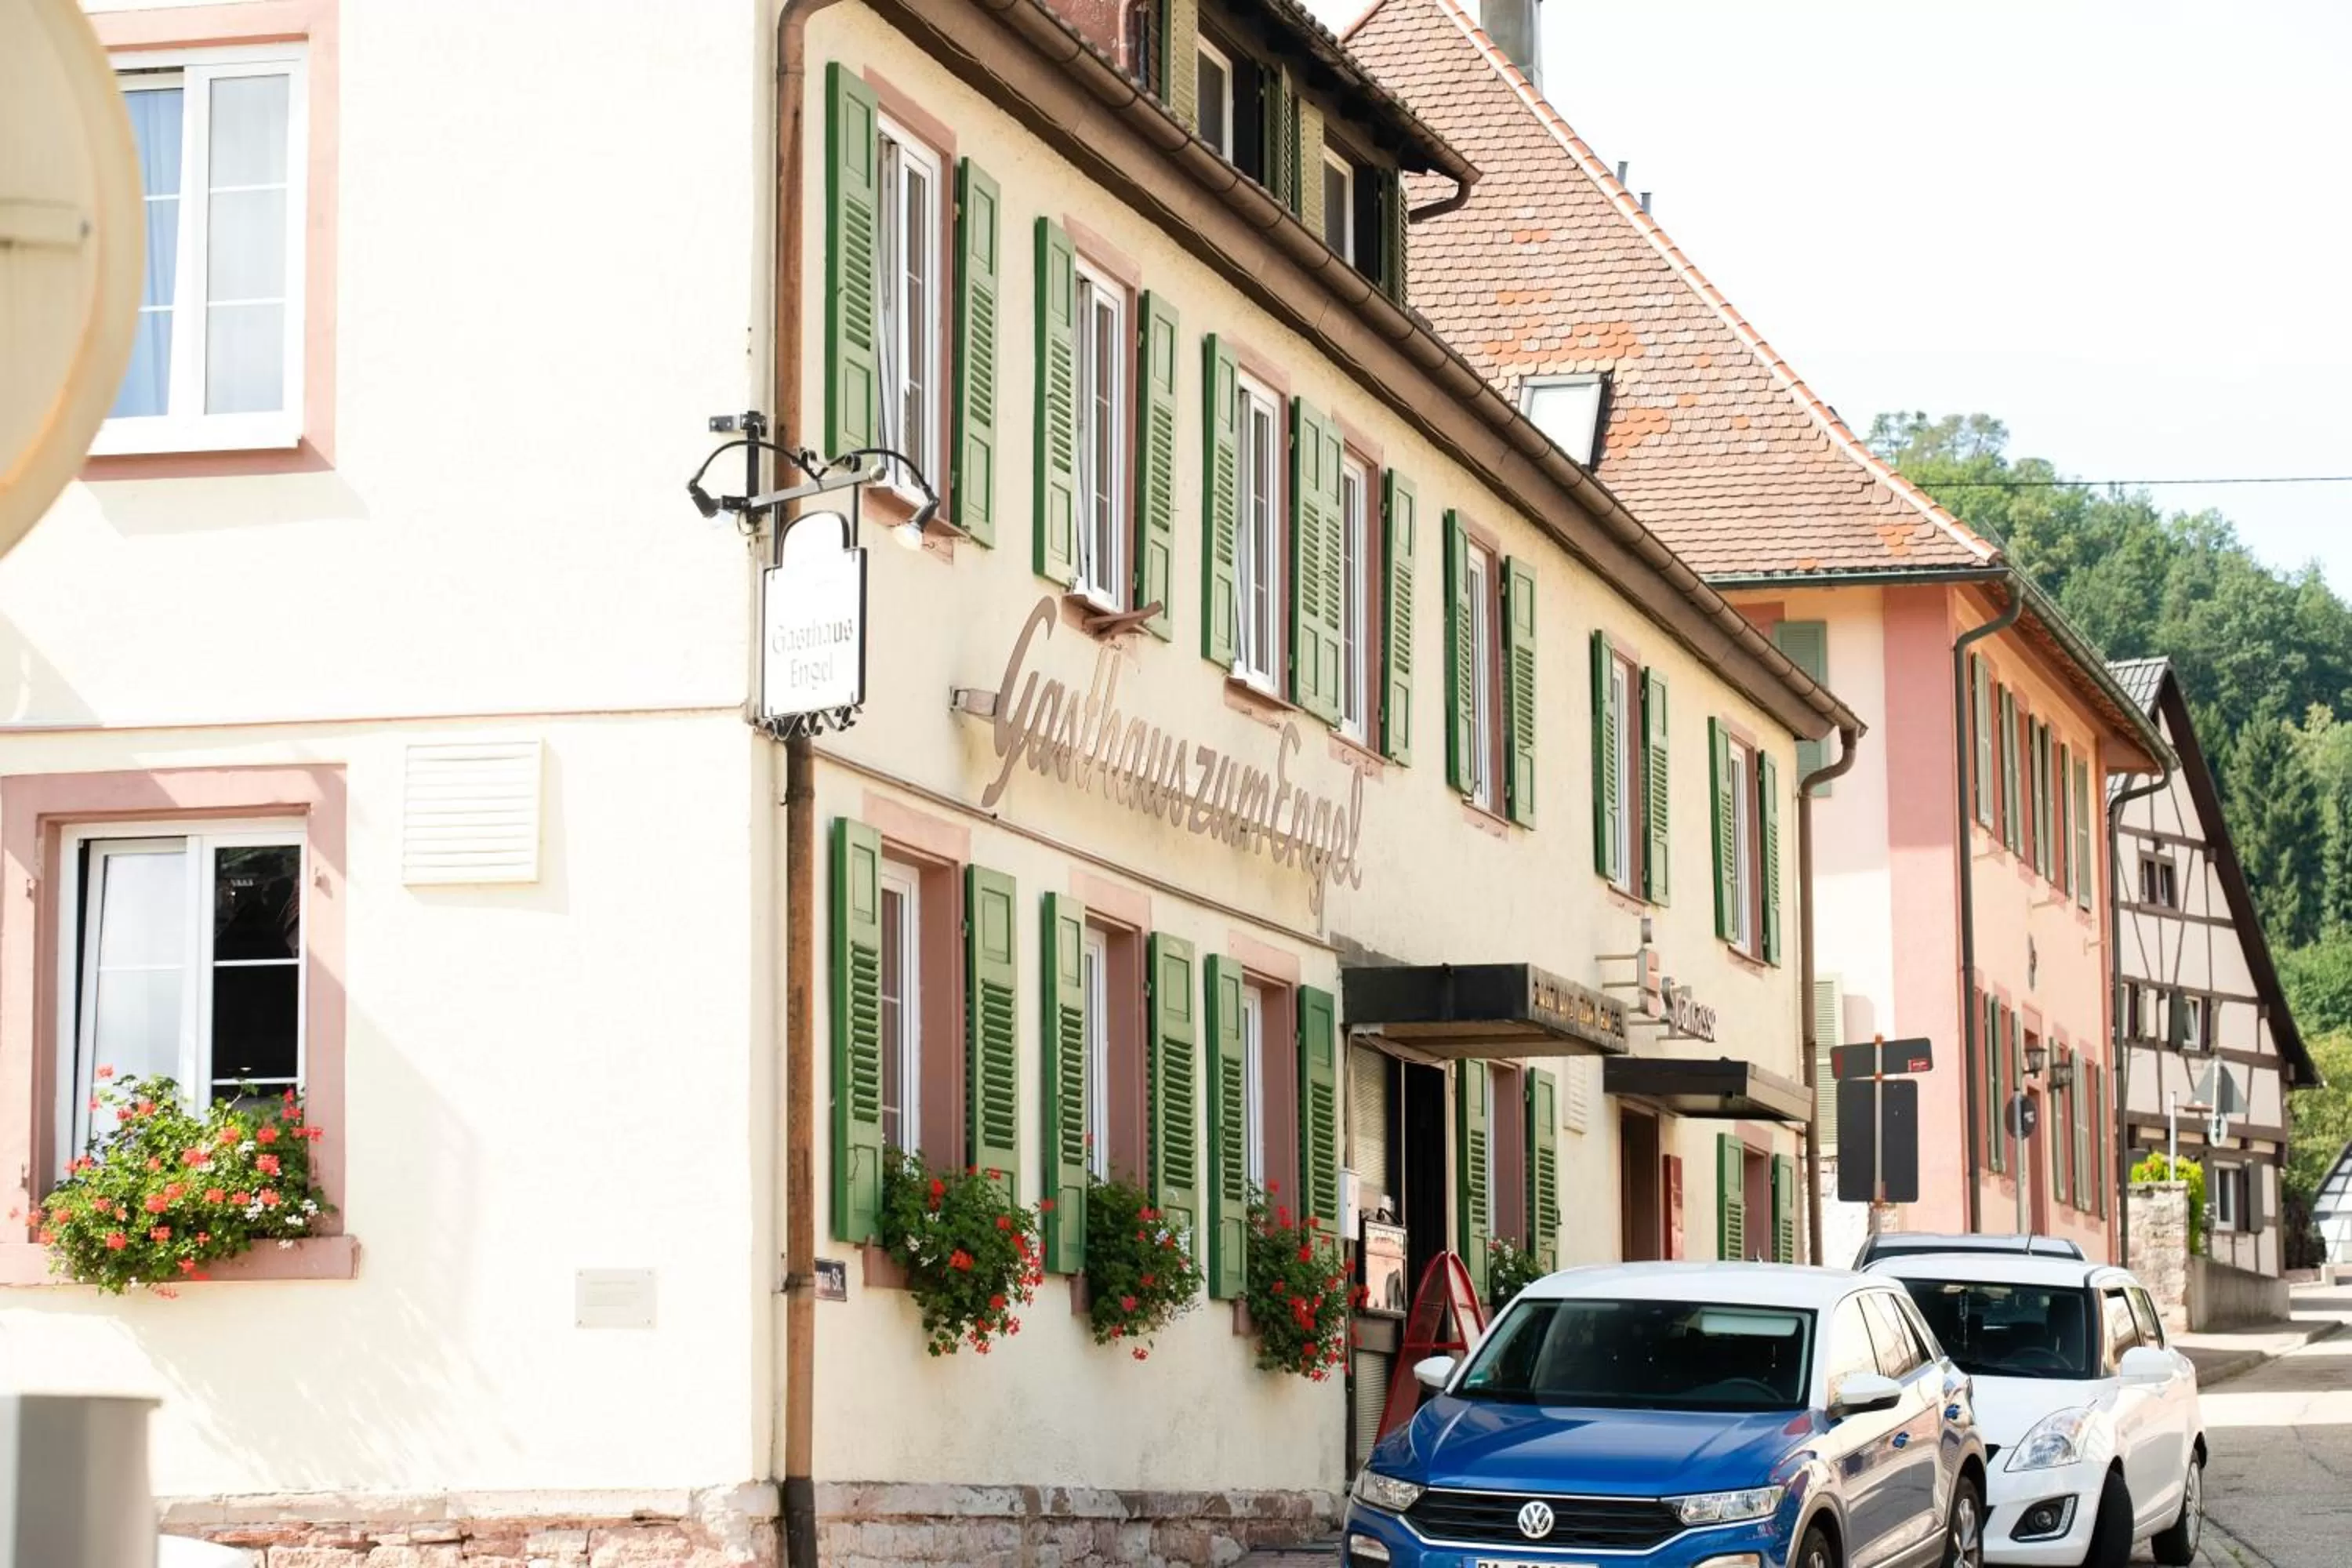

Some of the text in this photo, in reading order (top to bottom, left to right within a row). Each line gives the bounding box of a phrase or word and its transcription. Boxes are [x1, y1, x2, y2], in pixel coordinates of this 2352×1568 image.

[772, 618, 854, 654] Gasthaus
[790, 652, 834, 691] Engel
[982, 595, 1364, 916] Gasthaus zum Engel
